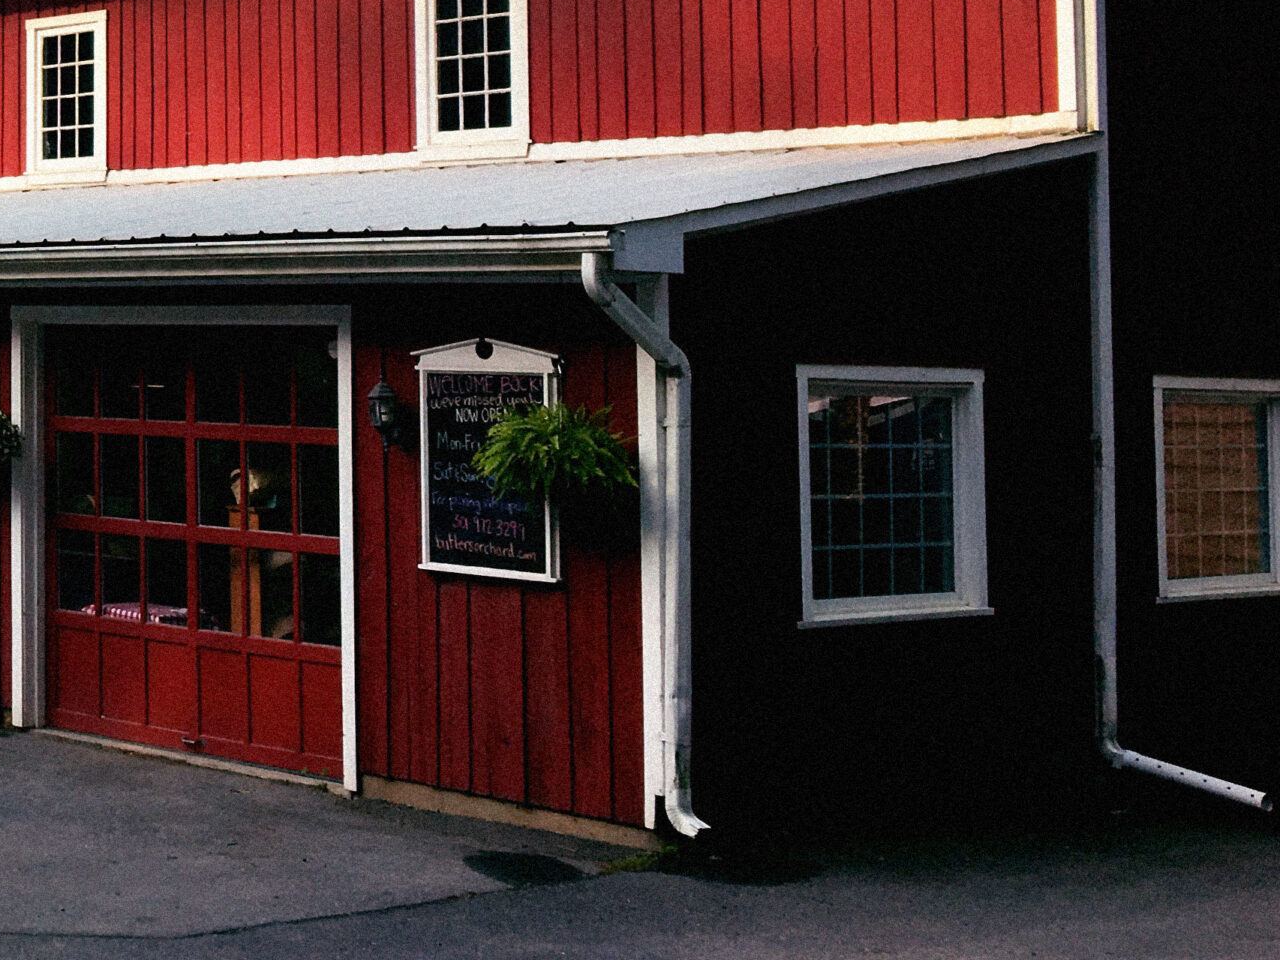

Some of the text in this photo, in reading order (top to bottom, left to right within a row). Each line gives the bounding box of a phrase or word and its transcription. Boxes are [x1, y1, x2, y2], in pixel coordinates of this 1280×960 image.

[429, 375, 494, 397] WELCOME
[463, 392, 503, 408] missed
[455, 408, 479, 423] NOW
